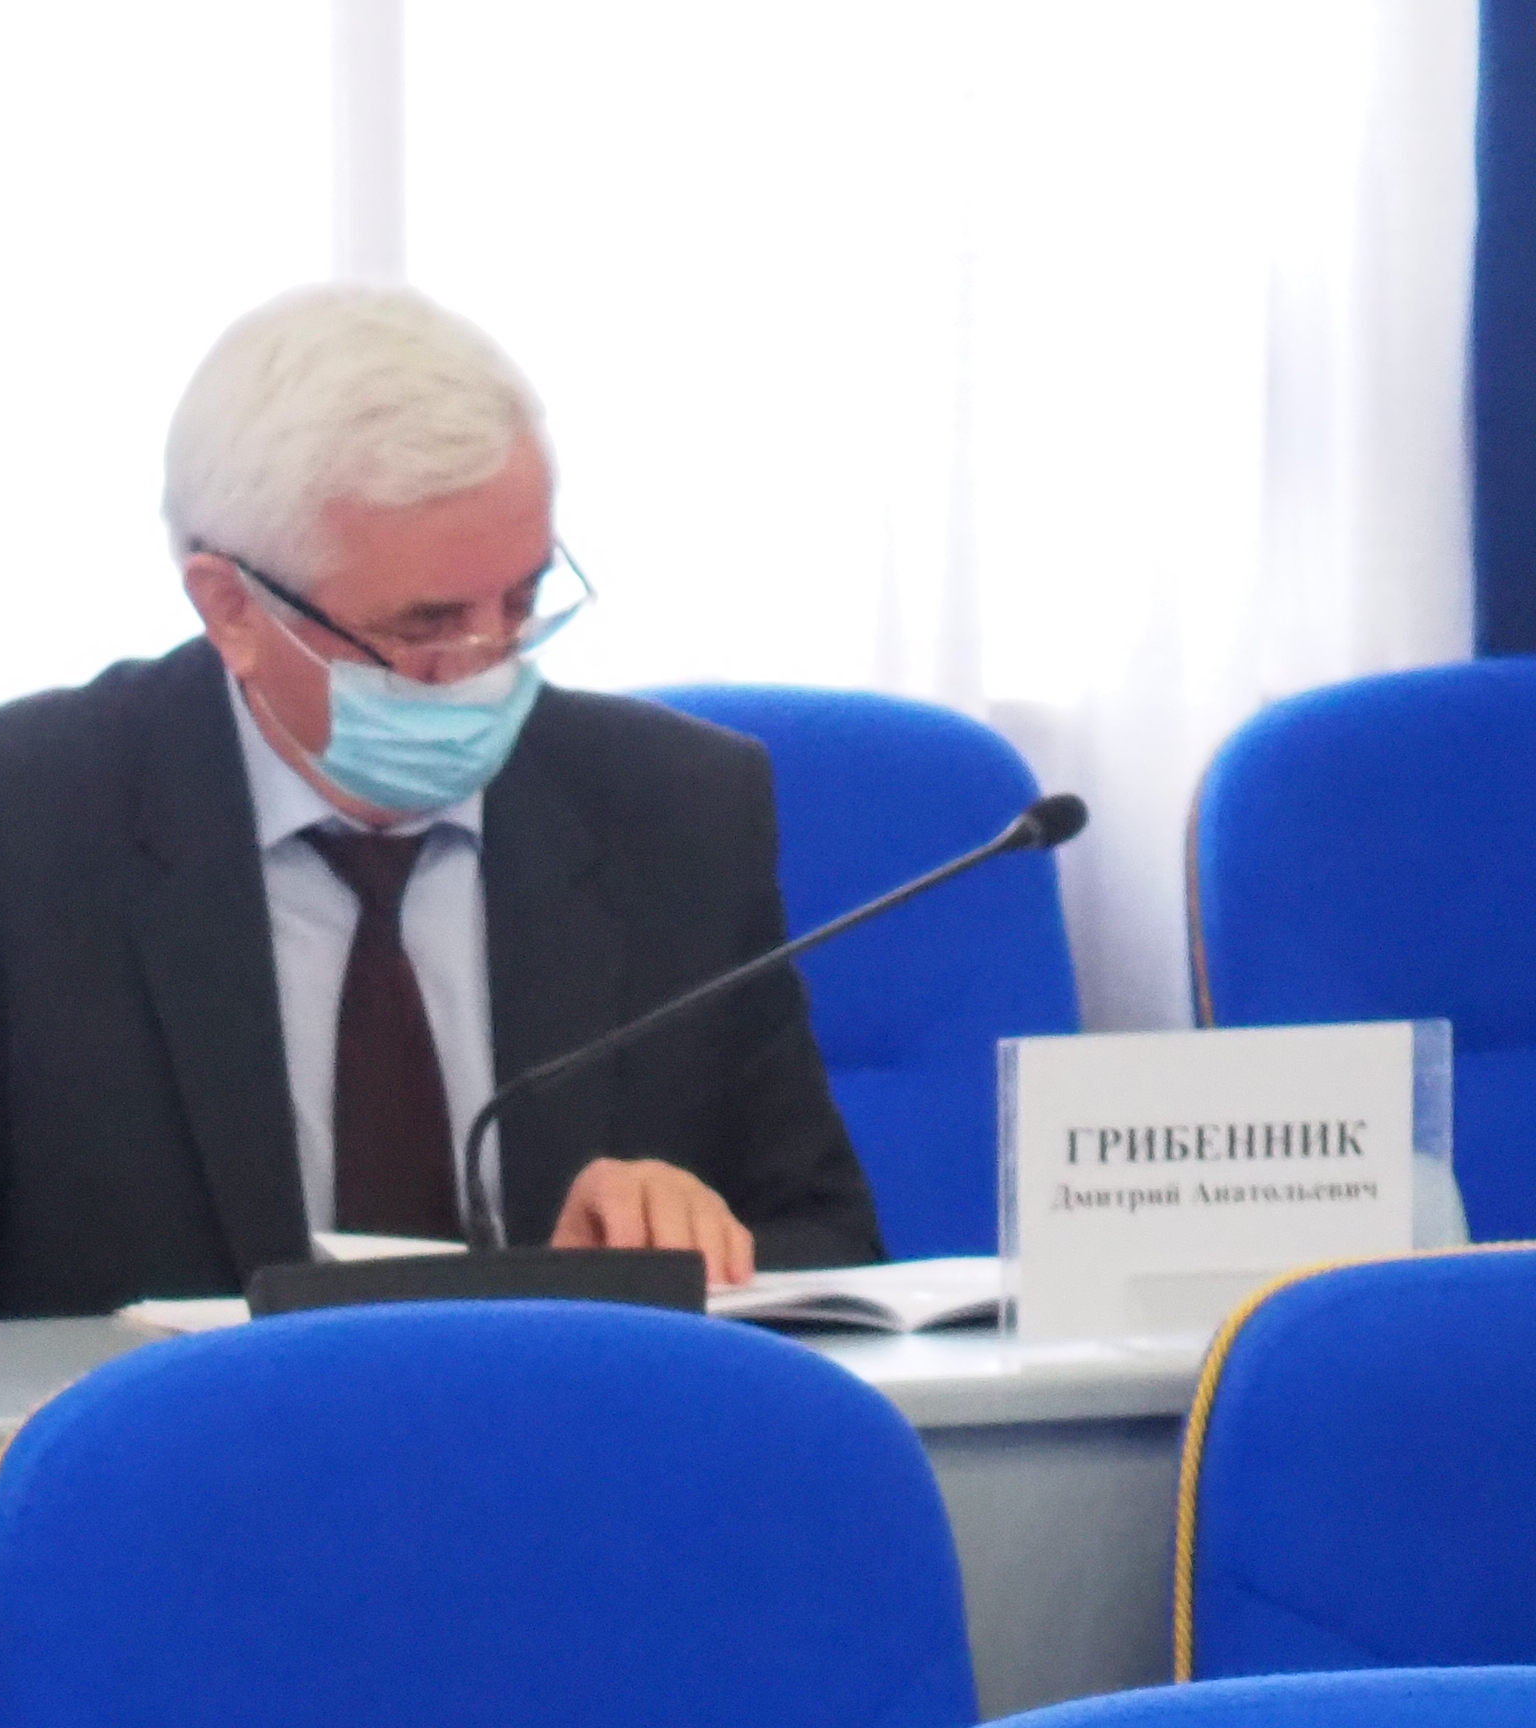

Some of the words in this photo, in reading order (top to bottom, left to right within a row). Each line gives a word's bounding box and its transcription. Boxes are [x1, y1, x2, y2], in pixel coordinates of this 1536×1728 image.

[1066, 1118, 1368, 1165] ГРИБЕННИК
[1050, 1180, 1180, 1214] Дмитрий
[1195, 1177, 1378, 1206] Анатольевич
